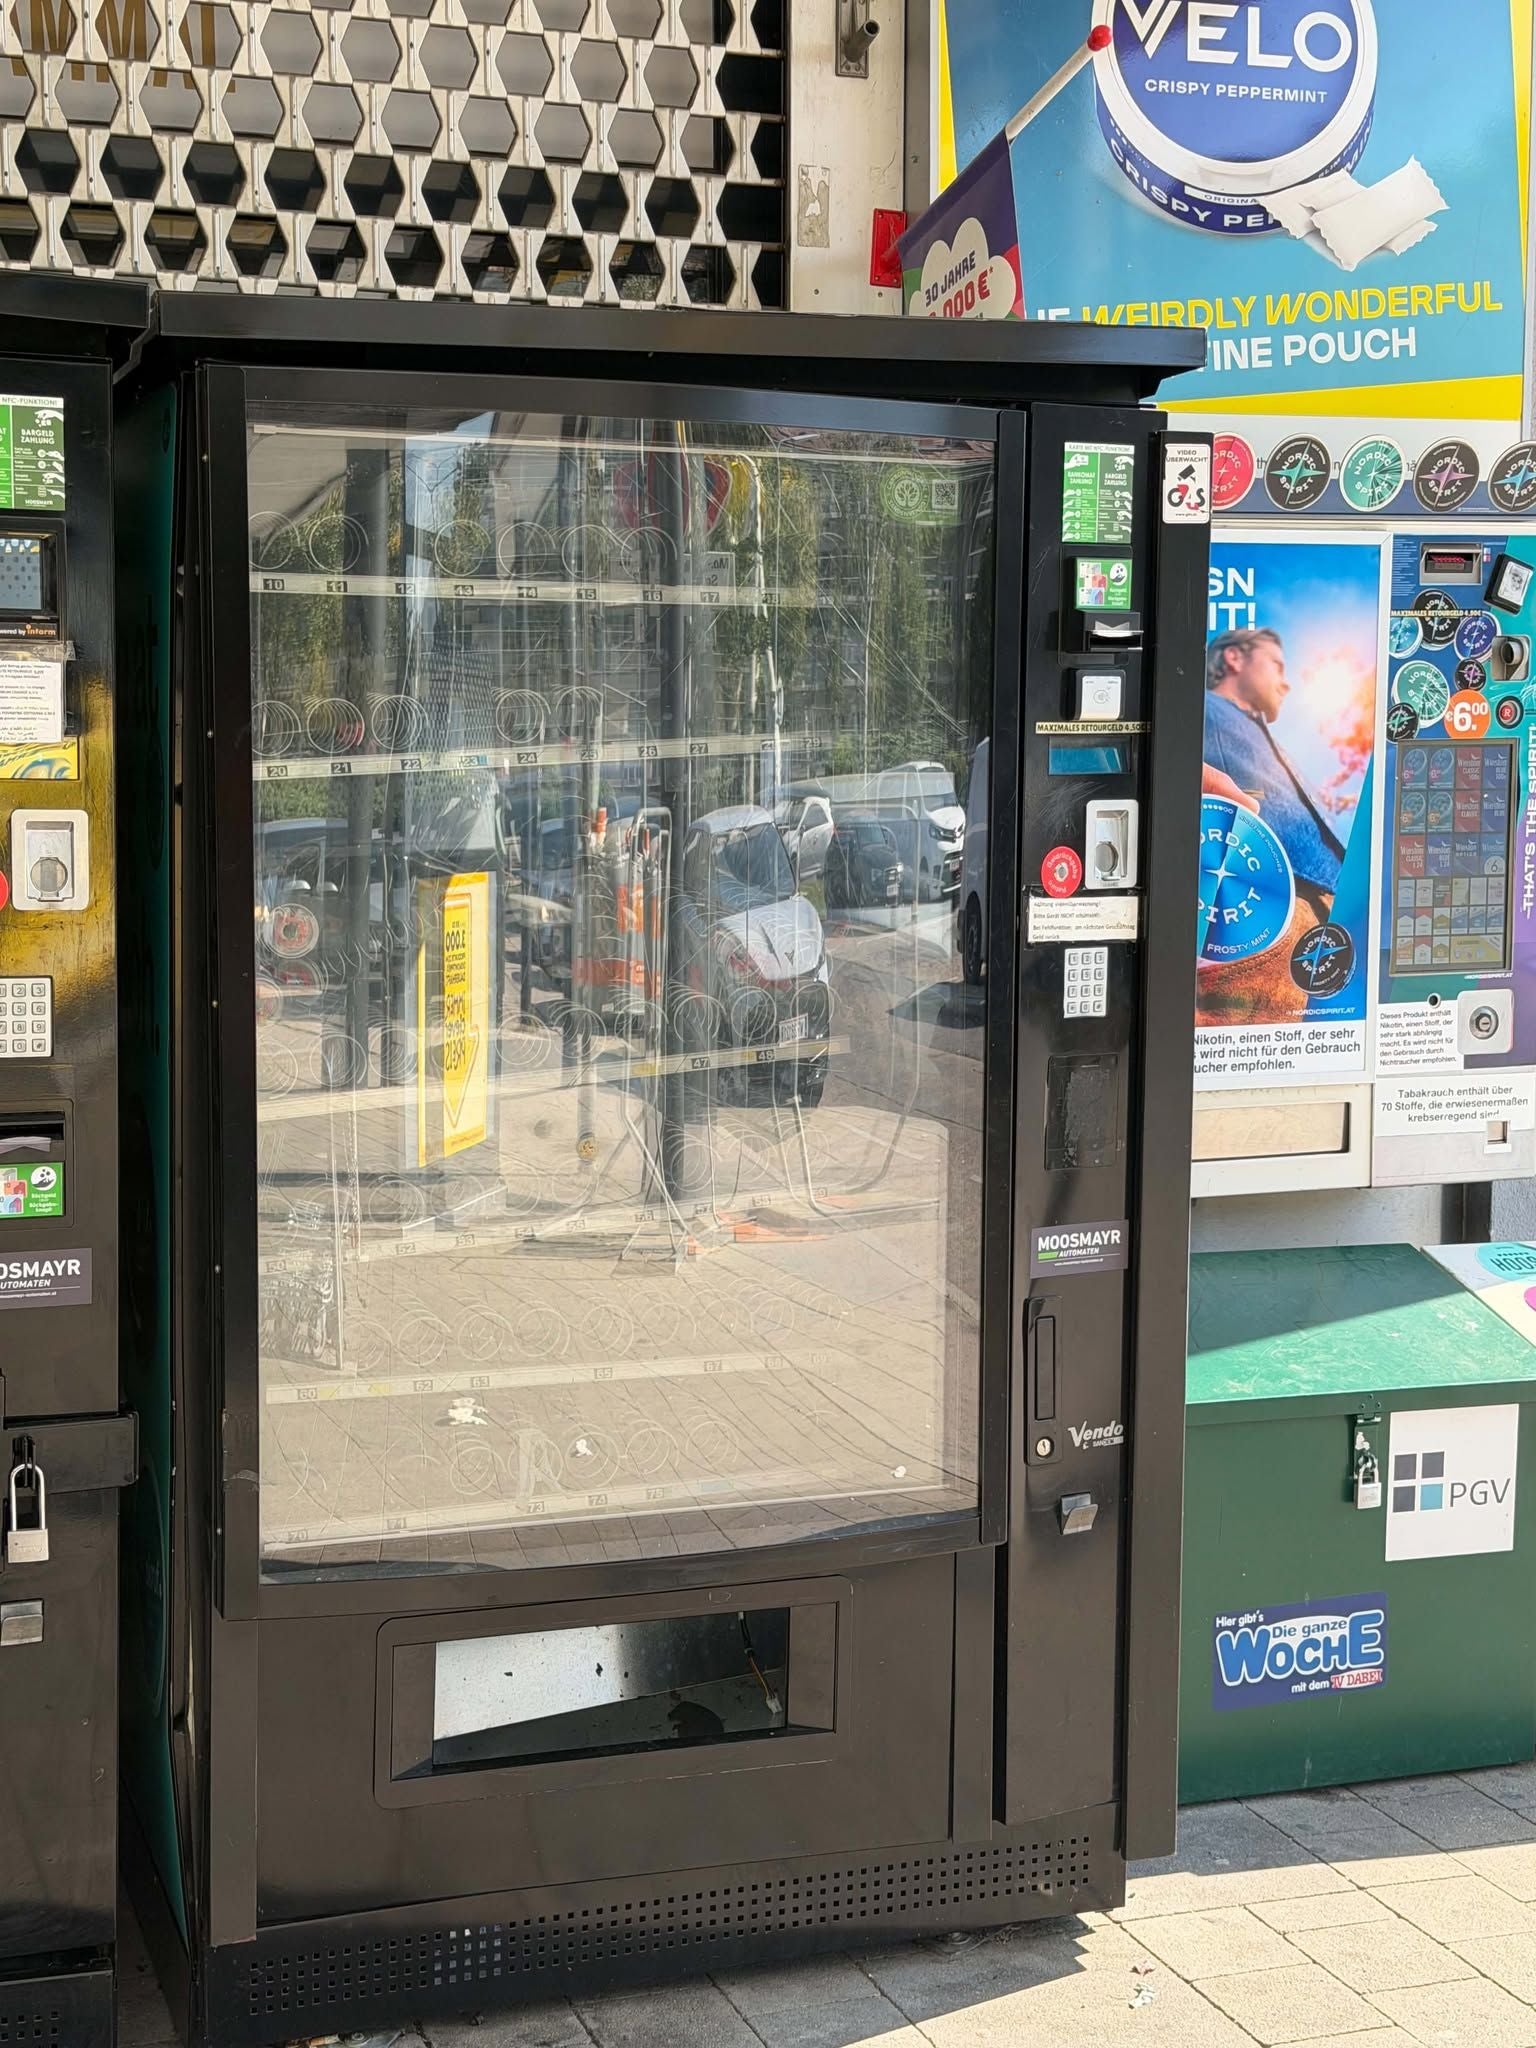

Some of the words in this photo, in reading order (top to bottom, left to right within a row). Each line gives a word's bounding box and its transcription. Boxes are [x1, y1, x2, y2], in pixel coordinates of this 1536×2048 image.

[1116, 0, 1352, 72] VELO
[1144, 78, 1211, 96] CRISPY
[1216, 84, 1328, 104] PEPPERMINT
[1110, 137, 1212, 223] CRISPY
[925, 284, 939, 307] 30
[940, 249, 976, 295] JAHRE
[1083, 295, 1260, 331] WEIRDLY
[1264, 280, 1504, 322] WONDERFUL
[1284, 326, 1418, 364] POUCH
[20, 436, 55, 445] ZAHLUNG
[21, 428, 55, 437] BARGELD
[1281, 452, 1317, 471] NORDIC
[1353, 451, 1393, 475] NORDIC
[1430, 456, 1466, 475] NORDIC
[1279, 476, 1314, 494] SPIRIT
[1354, 472, 1393, 497] SPIRIT
[1428, 479, 1463, 497] SPIRIT
[267, 580, 284, 591] 10
[331, 581, 348, 592] 11
[399, 583, 415, 594] 12
[456, 585, 473, 596] 13
[521, 587, 537, 598] 14
[580, 588, 596, 599] 15
[644, 591, 662, 602] 16
[702, 592, 719, 603] 17
[1504, 708, 1511, 717] R
[1037, 724, 1080, 732] MAXIMALES
[1081, 723, 1124, 731] RETOURGELD
[268, 765, 287, 777] 20
[333, 763, 350, 773] 21
[402, 759, 421, 770] 22
[462, 756, 479, 766] 23
[518, 752, 536, 764] 24
[581, 750, 597, 761] 25
[639, 746, 658, 757] 26
[691, 743, 708, 754] 27
[804, 737, 822, 748] 29
[1525, 798, 1536, 837] THE
[1523, 842, 1535, 911] THAT'S
[1207, 942, 1249, 954] FROSTY
[1250, 927, 1271, 947] MINT
[1303, 935, 1337, 955] NORDIC
[1302, 953, 1336, 975] SPIRIT
[1380, 1012, 1401, 1020] Dieses
[1430, 1009, 1451, 1017] enthält
[1239, 1031, 1271, 1043] einen
[1274, 1029, 1304, 1042] Stoff,
[1308, 1029, 1327, 1040] der
[1330, 1027, 1355, 1039] sehr
[1413, 1029, 1443, 1038] abhängig
[693, 1057, 709, 1068] 47
[758, 1050, 774, 1061] 48
[1200, 1047, 1225, 1059] wird
[1228, 1045, 1258, 1058] nicht
[1261, 1044, 1277, 1056] für
[1280, 1044, 1302, 1055] den
[1305, 1041, 1361, 1054] Gebrauch
[1194, 1062, 1228, 1073] ucher
[1231, 1058, 1296, 1074] empfohlen.
[1380, 1058, 1420, 1066] Nichtraucher
[1398, 1089, 1454, 1098] Tabakrauch
[1457, 1087, 1489, 1096] enthält
[1491, 1086, 1513, 1095] über
[1381, 1102, 1393, 1111] 70
[1395, 1101, 1426, 1111] Stoffe,
[1428, 1100, 1443, 1109] die
[1445, 1097, 1529, 1108] erwiesenermaßen
[1408, 1112, 1477, 1122] krebserregend
[1037, 1229, 1121, 1251] MOOSMAYR
[266, 1260, 286, 1272] 50
[397, 1243, 415, 1255] 52
[456, 1235, 474, 1246] 53
[1058, 1247, 1100, 1258] AUTOMATEN
[0, 1278, 52, 1289] UTOMATEN
[299, 1388, 317, 1400] 60
[415, 1380, 432, 1391] 62
[472, 1376, 489, 1387] 63
[704, 1361, 721, 1371] 67
[1068, 1420, 1124, 1448] Vendo
[1450, 1478, 1511, 1507] PGV
[528, 1503, 545, 1513] 73
[1216, 1616, 1236, 1628] Hier
[1238, 1610, 1264, 1627] gibt's
[1272, 1626, 1297, 1639] Die
[1302, 1619, 1347, 1638] ganze
[1291, 1680, 1307, 1693] mit
[1308, 1680, 1330, 1691] dem
[1331, 1676, 1344, 1689] TV
[1346, 1670, 1383, 1686] DABEI
